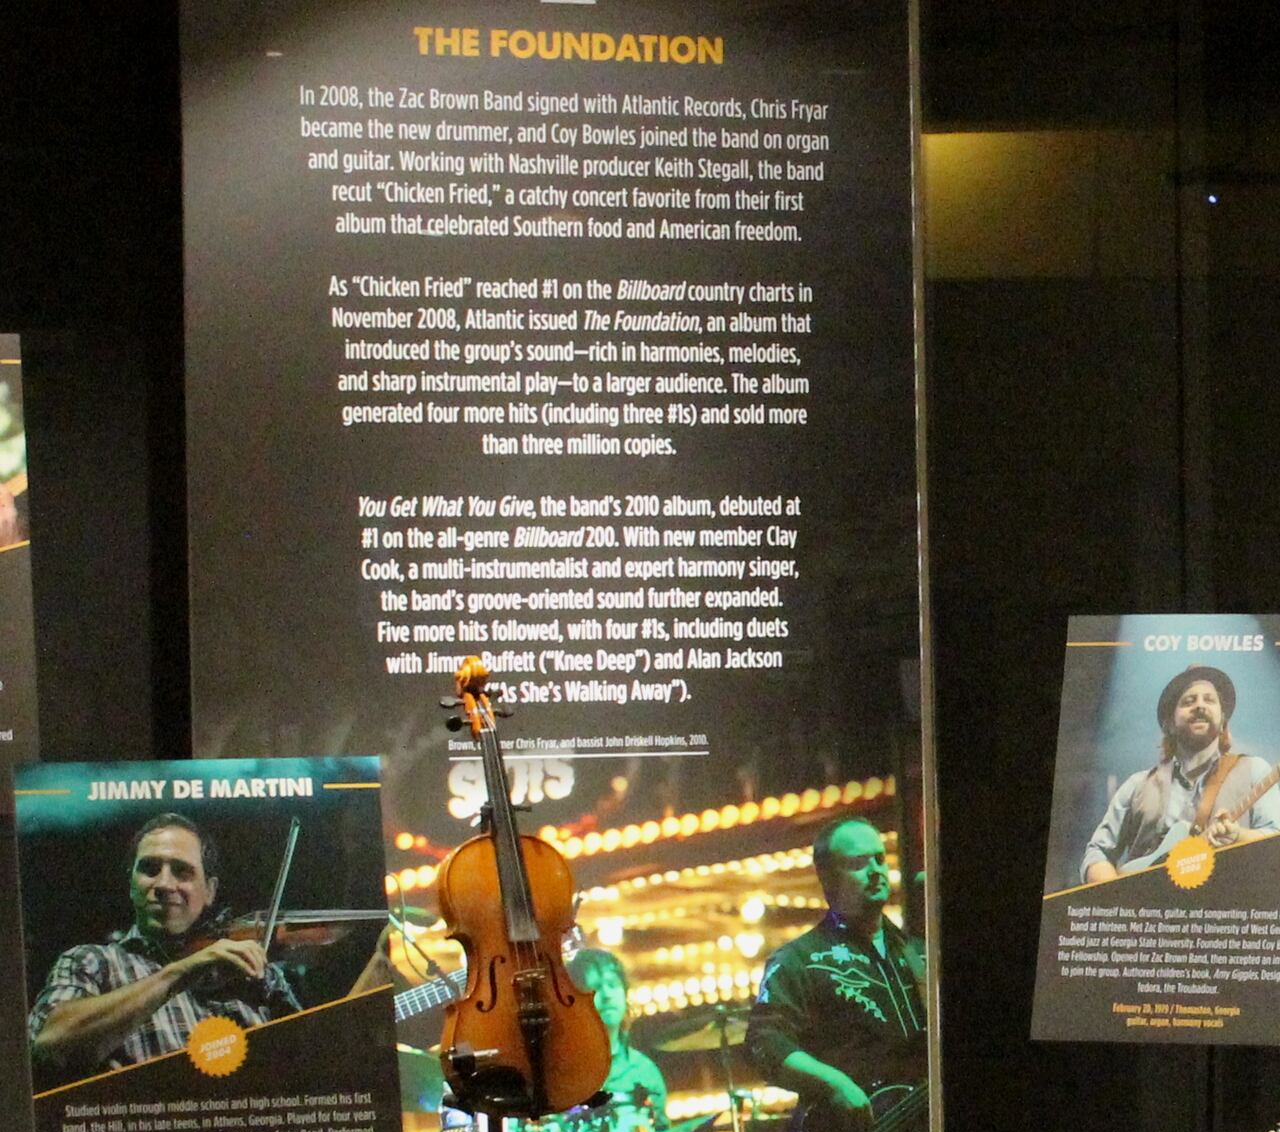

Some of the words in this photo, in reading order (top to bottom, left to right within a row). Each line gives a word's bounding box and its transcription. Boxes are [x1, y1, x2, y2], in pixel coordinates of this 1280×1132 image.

[413, 28, 480, 58] THE
[490, 30, 722, 64] FOUNDATION
[300, 86, 315, 106] In
[320, 83, 363, 114] 2008,
[366, 84, 395, 109] the
[395, 85, 425, 110] Zac
[427, 89, 479, 111] Brown
[484, 91, 523, 112] Band
[527, 92, 578, 116] signed
[583, 94, 617, 114] with
[622, 95, 679, 116] Atlantic
[685, 97, 746, 120] Records,
[751, 100, 786, 119] Chris
[792, 101, 827, 123] Fryar
[300, 115, 363, 140] became
[364, 116, 394, 144] the
[397, 123, 431, 141] new
[436, 121, 513, 145] drummer,
[517, 124, 546, 144] and
[551, 124, 577, 148] Coy
[583, 125, 636, 146] Bowles
[640, 127, 687, 149] joined
[693, 129, 716, 148] the
[722, 129, 758, 149] band
[764, 135, 781, 149] on
[787, 136, 828, 154] organ
[329, 276, 348, 297] As
[352, 277, 420, 298] “Chicken
[424, 277, 471, 299] Fried”
[476, 279, 537, 300] reached
[542, 280, 558, 300] #1
[562, 284, 582, 300] on
[586, 280, 612, 301] the
[617, 280, 686, 302] Billboard
[688, 283, 744, 305] country
[749, 283, 794, 303] charts
[799, 284, 812, 303] in
[359, 497, 387, 518] You
[390, 497, 418, 518] Get
[422, 497, 464, 518] What
[468, 497, 496, 518] You
[499, 496, 536, 520] Give,
[540, 497, 566, 517] the
[570, 496, 622, 517] band’s
[625, 496, 659, 517] 2010
[663, 496, 715, 519] album,
[720, 496, 781, 516] debuted
[786, 498, 800, 516] at
[1143, 634, 1179, 651] COY
[1187, 634, 1265, 651] BOWLES
[386, 653, 422, 674] with
[482, 651, 535, 673] Buffett
[539, 651, 593, 675] (“Knee
[596, 650, 650, 674] Deep”)
[654, 649, 683, 670] and
[687, 649, 721, 670] Alan
[725, 649, 782, 669] Jackson
[520, 682, 562, 704] She’s
[564, 681, 627, 705] Walking
[631, 680, 691, 704] Away”).
[88, 779, 167, 803] JIMMY
[173, 781, 203, 799] DE
[211, 777, 313, 798] MARTINI
